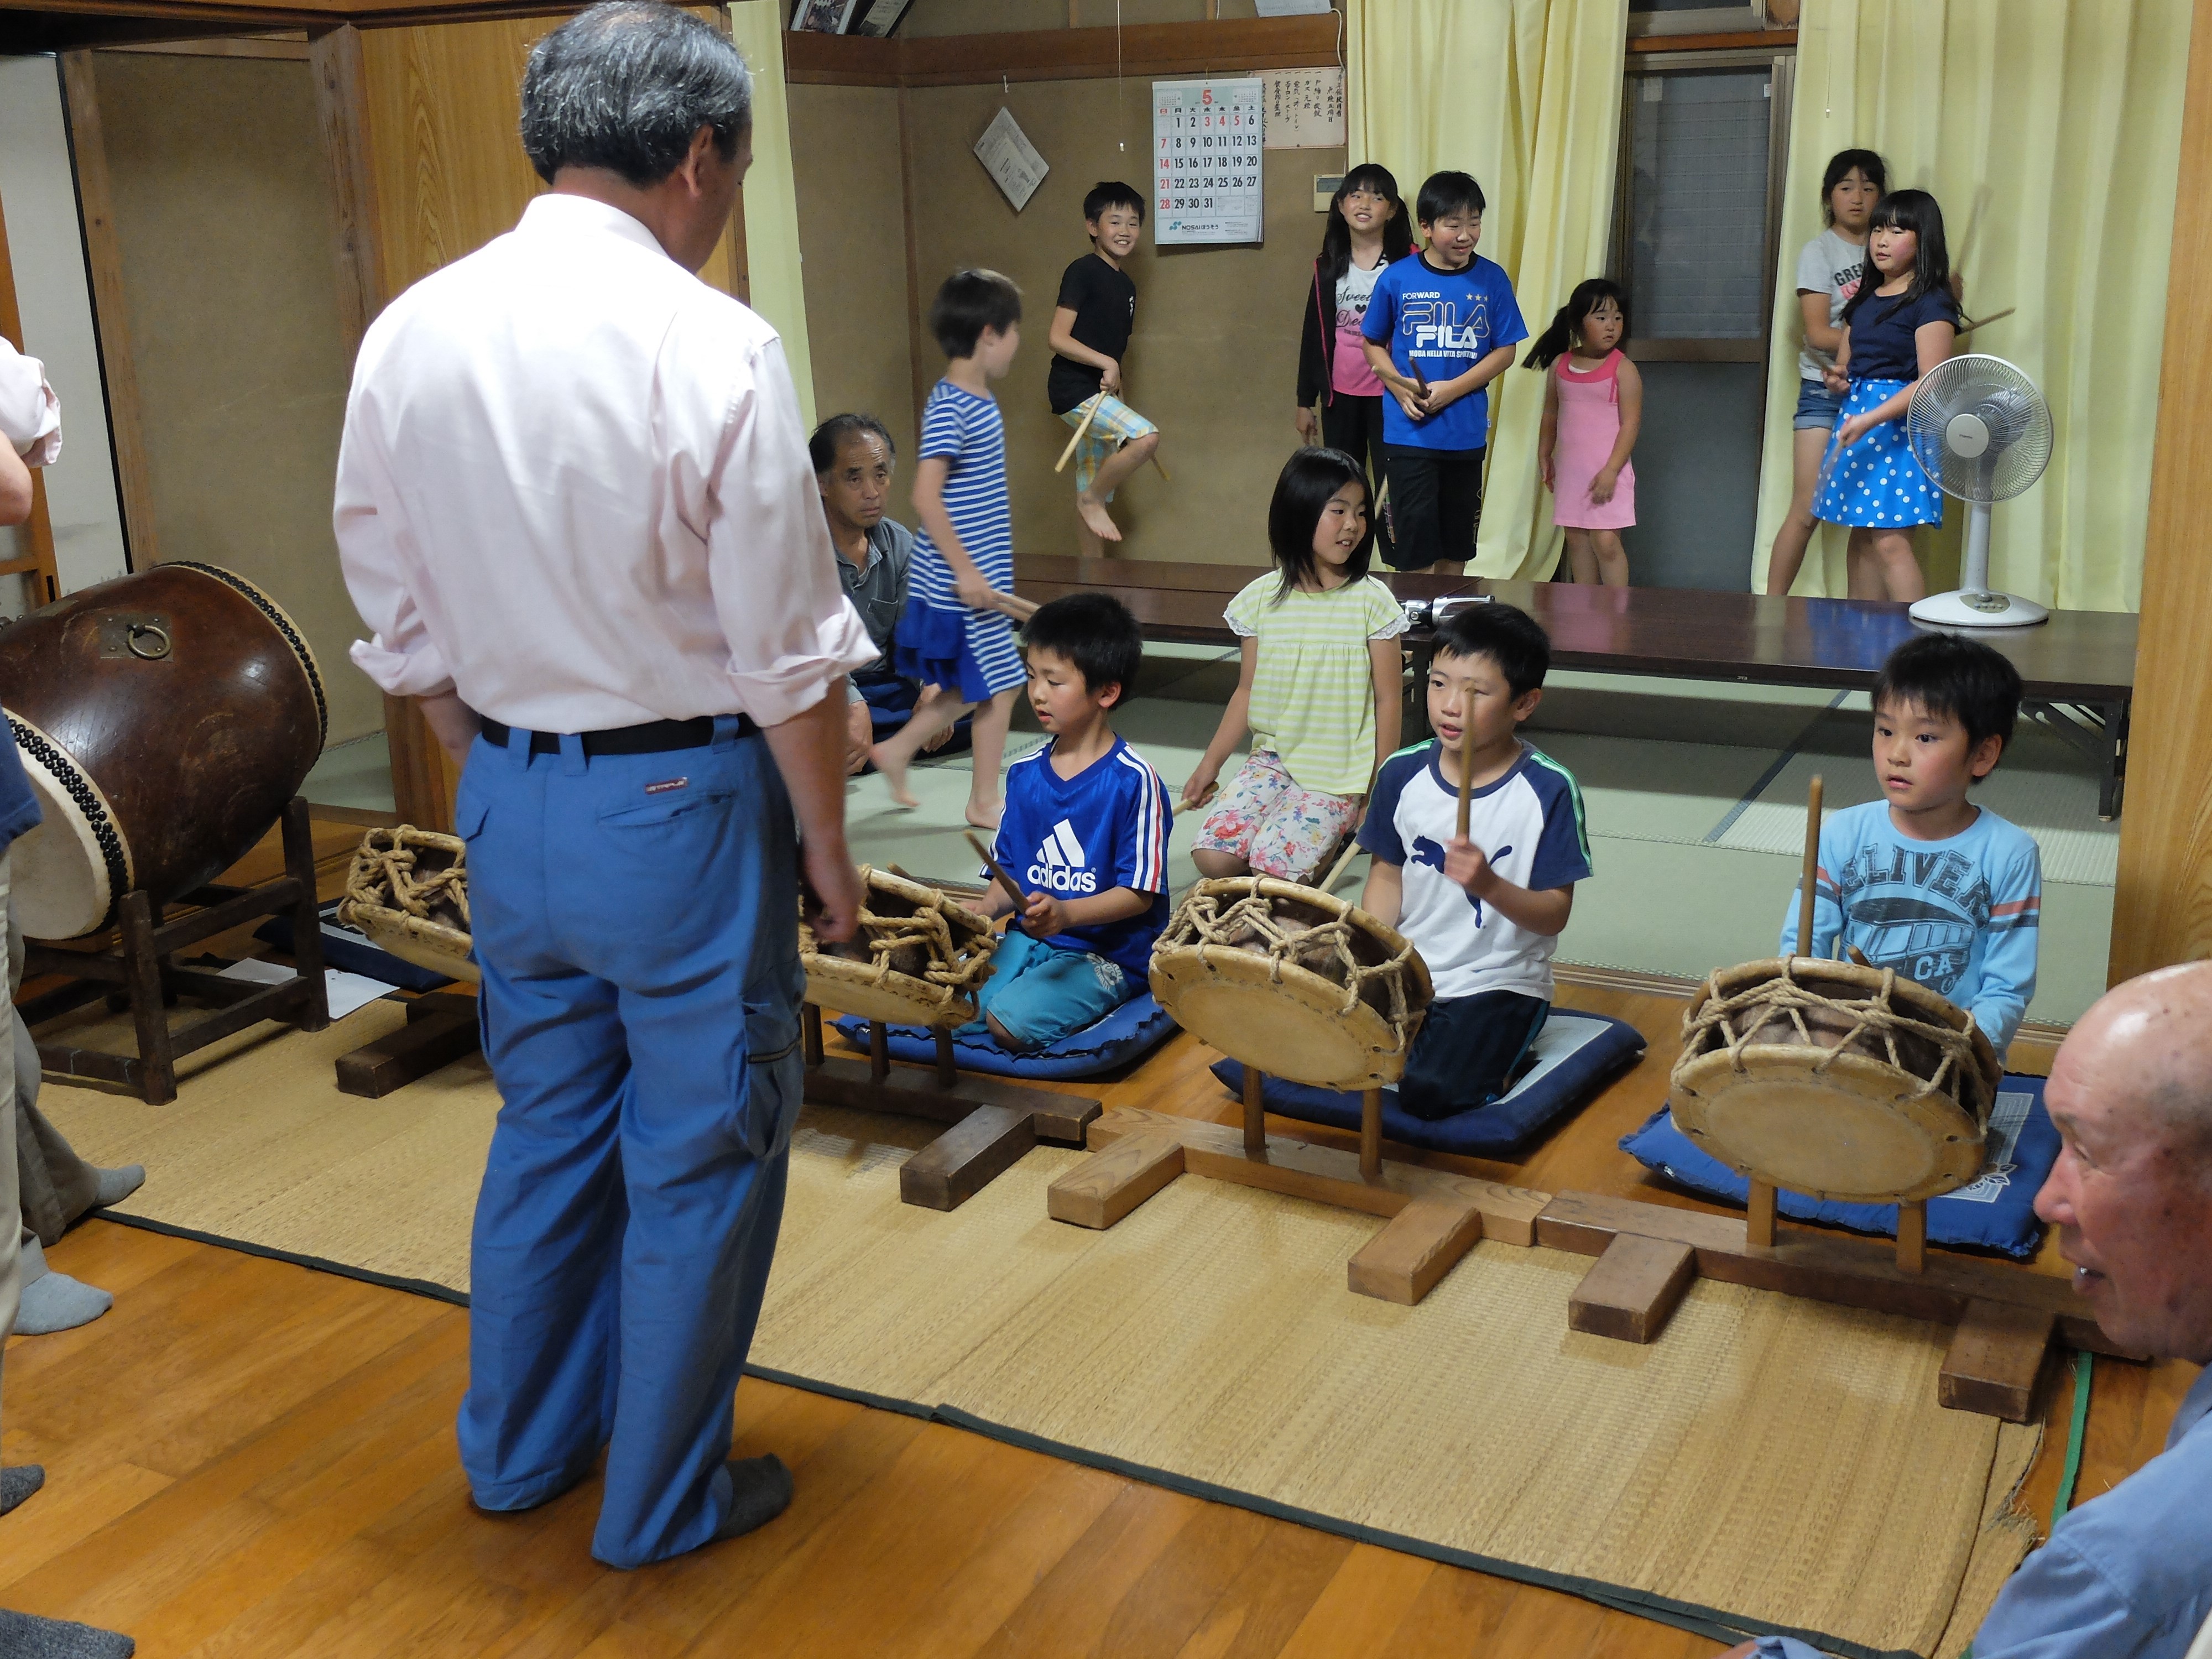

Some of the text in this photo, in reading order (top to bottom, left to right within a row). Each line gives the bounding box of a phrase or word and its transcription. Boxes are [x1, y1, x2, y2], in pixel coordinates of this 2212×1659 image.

[1202, 90, 1212, 105] 5
[1177, 115, 1254, 128] 1 2 3 4 5 6
[1161, 135, 1256, 148] 7 8 9 10 11 12 13
[1160, 156, 1257, 169] 14 15 16 17 18 19 20
[1160, 176, 1256, 189] 21 22 23 24 25 26 27
[1160, 200, 1170, 209] 28
[1175, 199, 1185, 208] 29
[1189, 199, 1199, 208] 30
[1204, 198, 1213, 207] 31
[1402, 302, 1490, 338] FILA
[1416, 325, 1478, 349] FILA
[1027, 863, 1096, 892] adidas
[1914, 953, 1953, 980] CA
